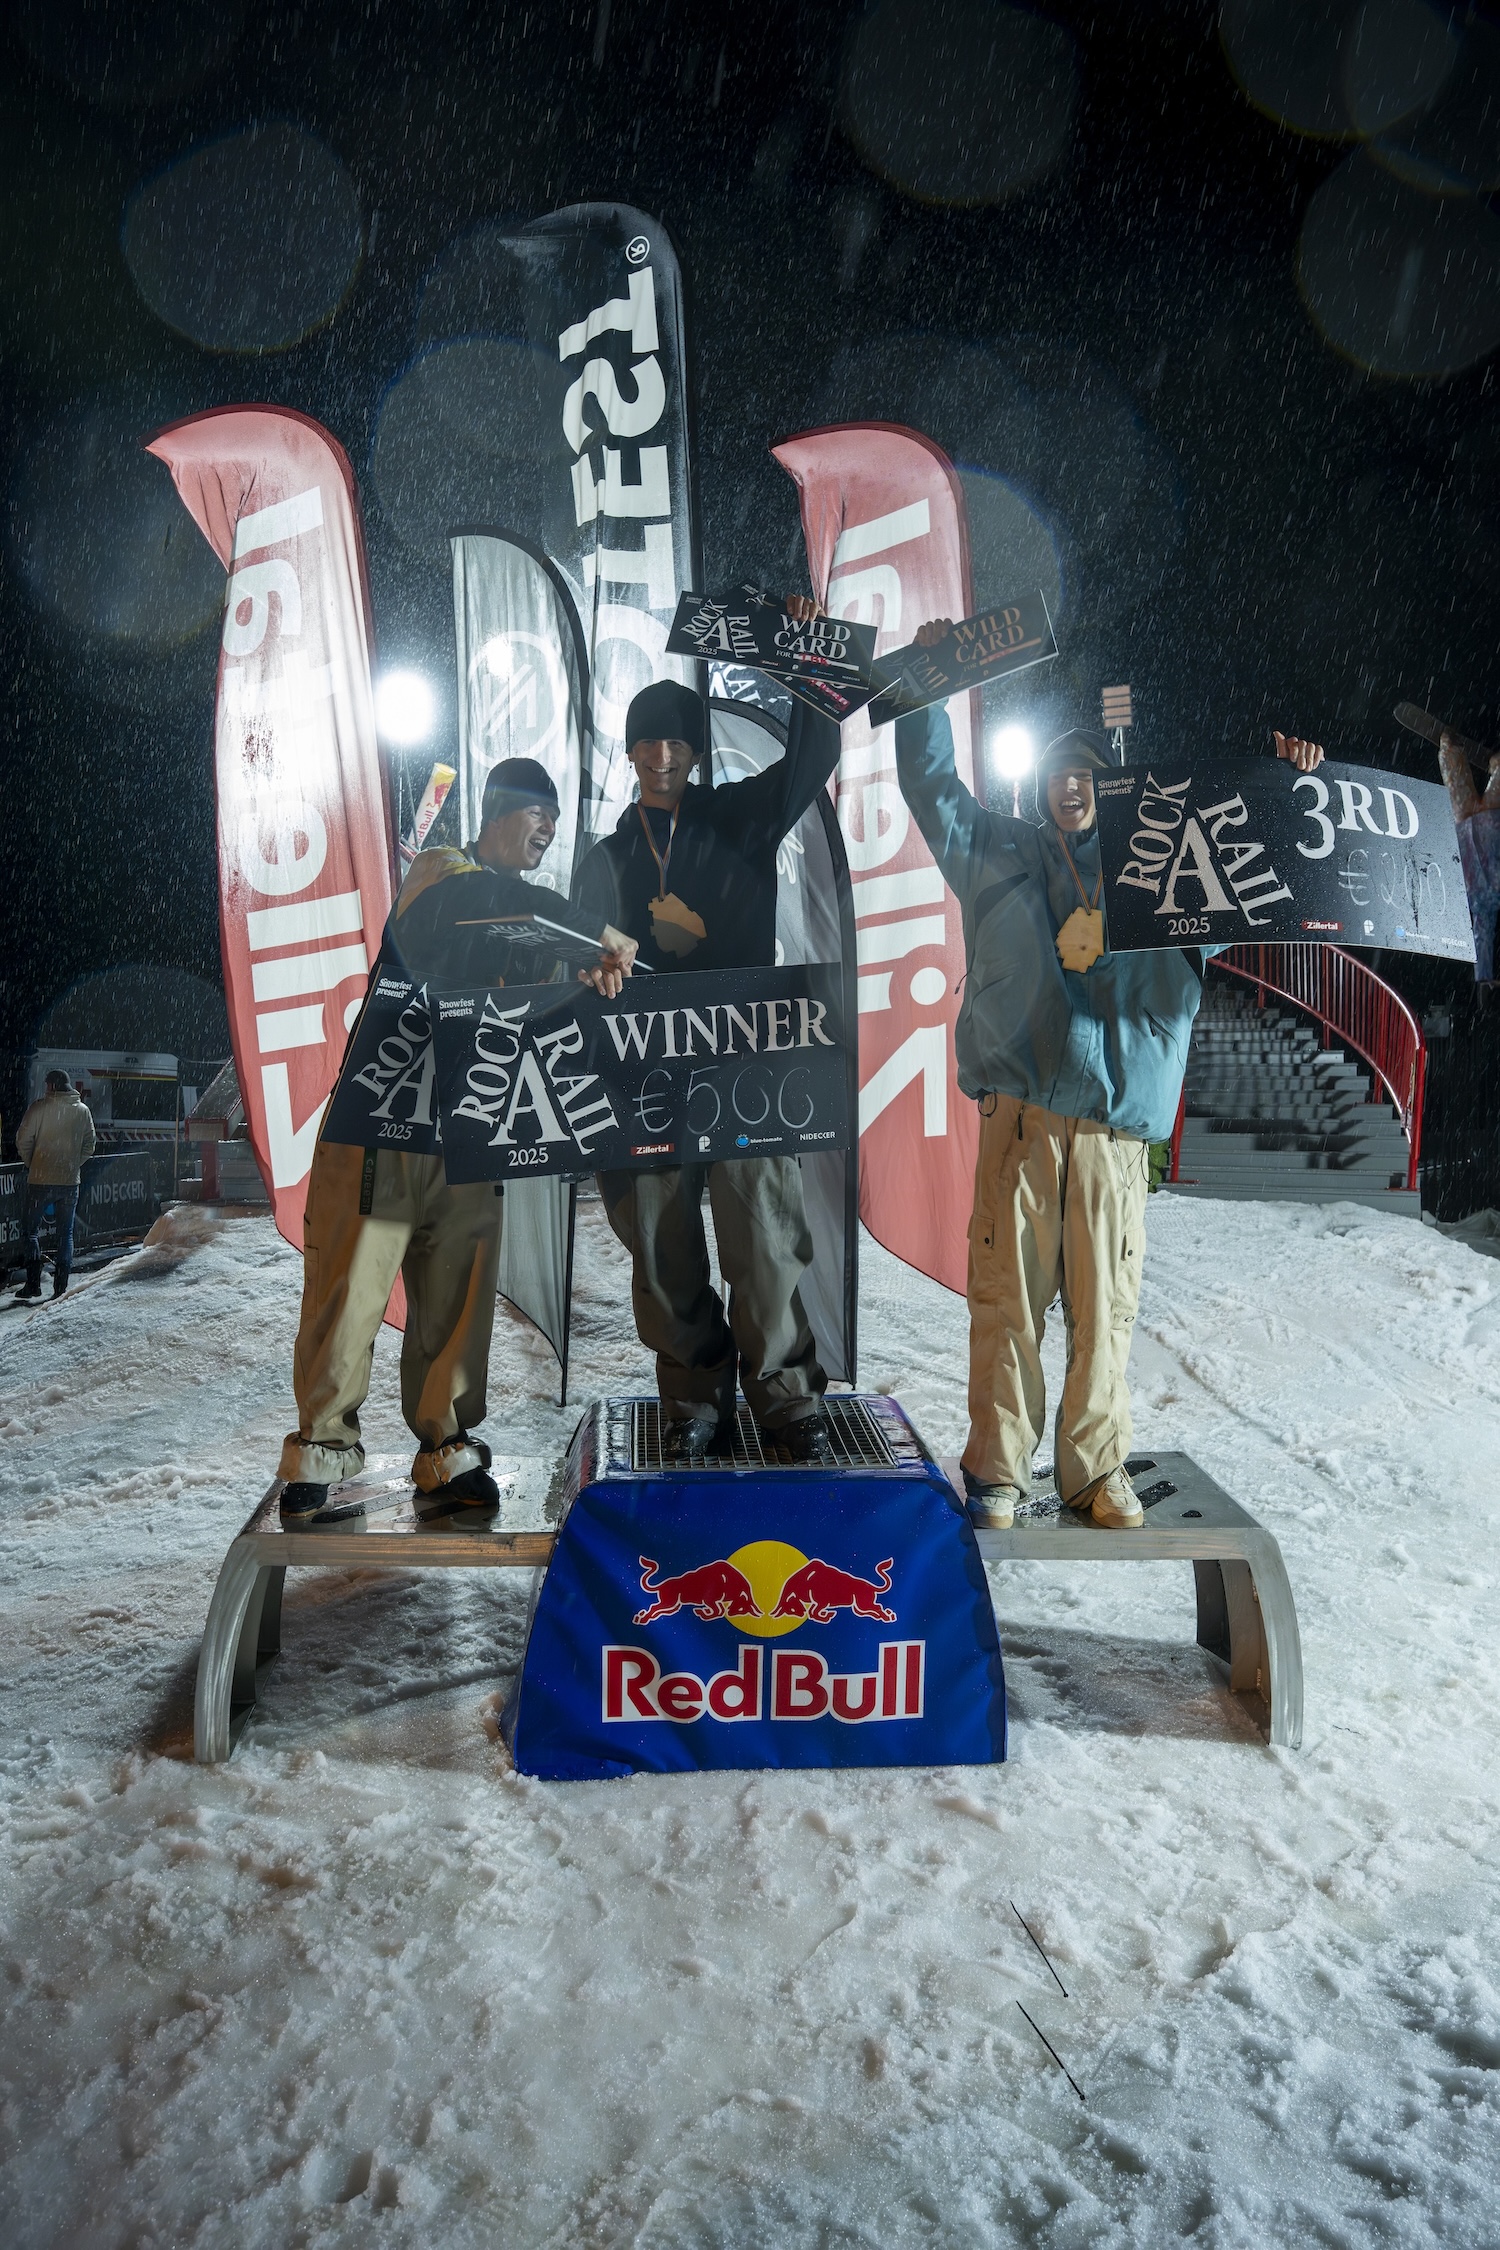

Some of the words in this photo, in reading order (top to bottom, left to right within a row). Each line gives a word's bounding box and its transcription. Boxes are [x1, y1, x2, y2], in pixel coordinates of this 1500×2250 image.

[680, 598, 729, 639] ROCK
[780, 614, 851, 642] WILD
[953, 607, 1021, 644] WILD
[693, 616, 733, 651] A
[727, 614, 759, 659] RAIL
[773, 630, 847, 660] CARD
[955, 625, 1024, 663] CARD
[697, 646, 718, 655] 2025
[775, 650, 791, 658] FOR
[1098, 777, 1136, 789] Snowfest
[1292, 775, 1420, 860] 3RD
[1116, 771, 1192, 897] ROCK
[1154, 817, 1238, 915] A
[1196, 792, 1295, 926] RAIL
[1167, 917, 1211, 936] 2025
[1306, 922, 1339, 931] Zillertal
[379, 977, 413, 991] Snowfest
[439, 998, 475, 1010] Snowfest
[439, 1008, 473, 1020] presents
[601, 998, 835, 1062] WINNER
[451, 993, 531, 1128] ROCK
[487, 1050, 571, 1147] A
[533, 1018, 620, 1155] RAIL
[377, 1122, 414, 1141] 2025
[800, 1131, 836, 1141] NIDECKER
[507, 1147, 549, 1167] 2025
[636, 1144, 669, 1155] Zillertal
[91, 1181, 145, 1205] NIDECKER
[602, 1645, 764, 1723] Red
[770, 1640, 926, 1724] Bull
